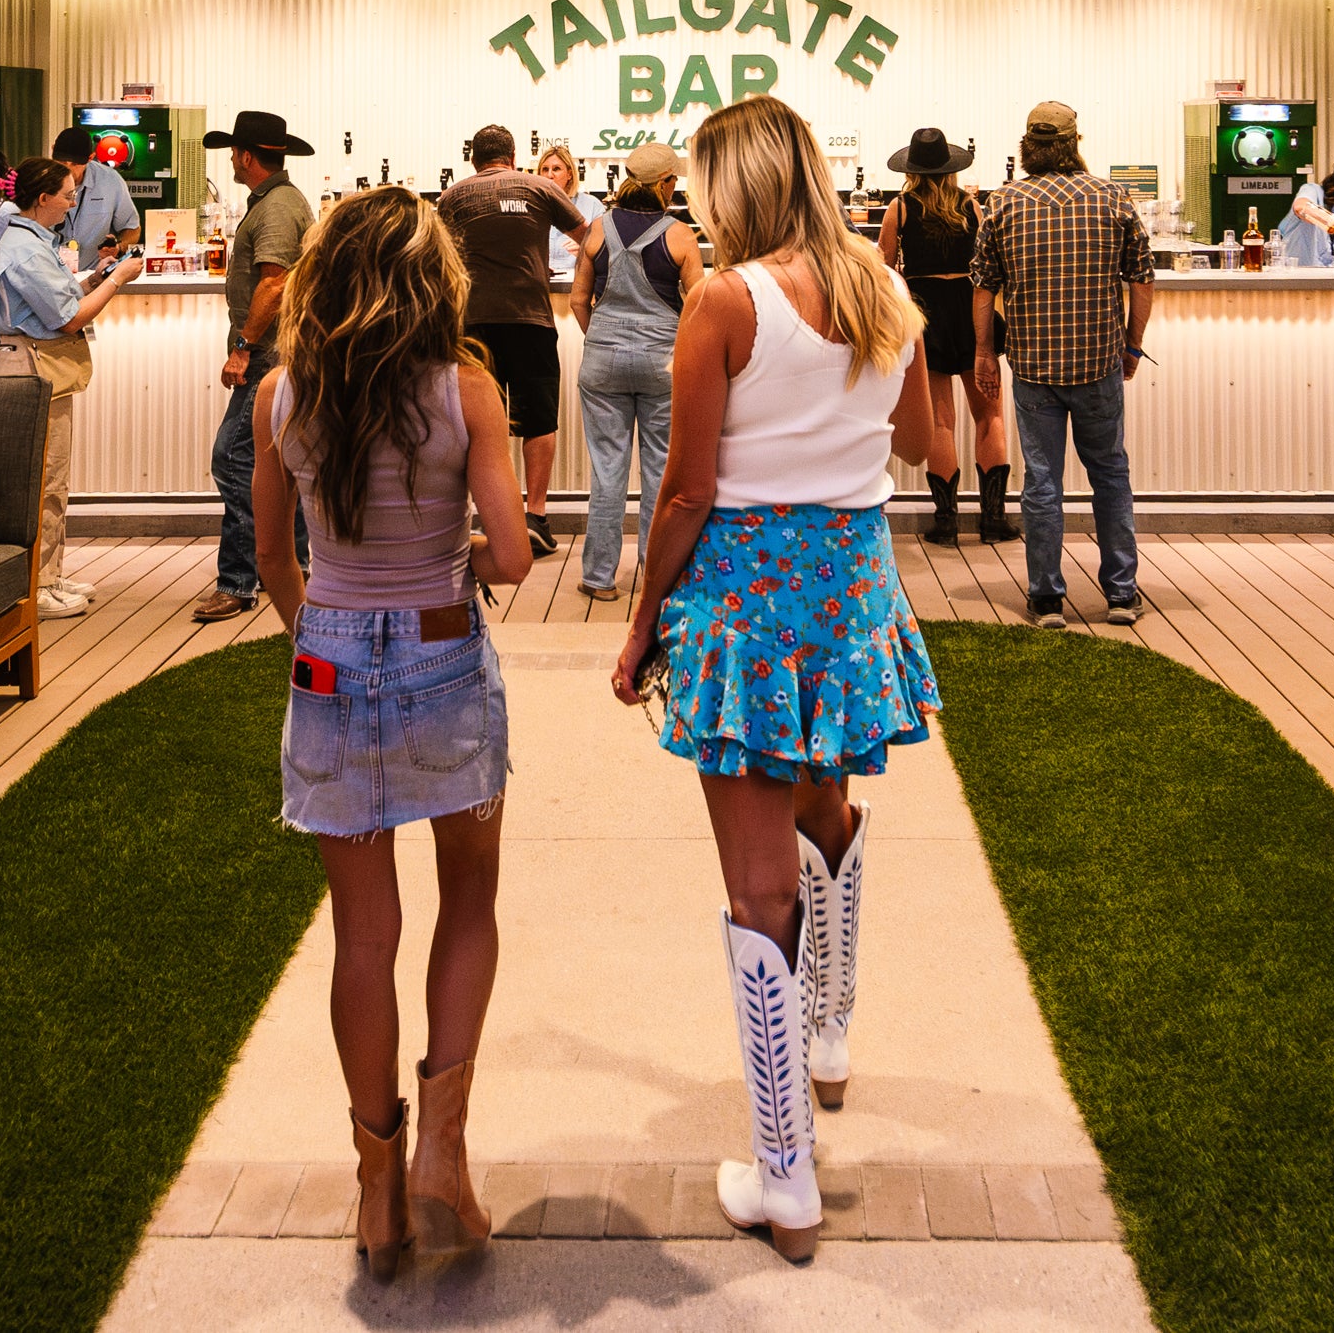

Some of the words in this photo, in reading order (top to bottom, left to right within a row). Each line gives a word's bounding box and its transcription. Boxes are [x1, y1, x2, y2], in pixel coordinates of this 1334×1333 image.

[618, 53, 779, 115] BAR
[537, 137, 570, 148] SINCE
[593, 128, 657, 151] Salt
[828, 136, 857, 147] 2025
[1241, 181, 1279, 190] LIMEADE
[499, 199, 529, 213] WORK
